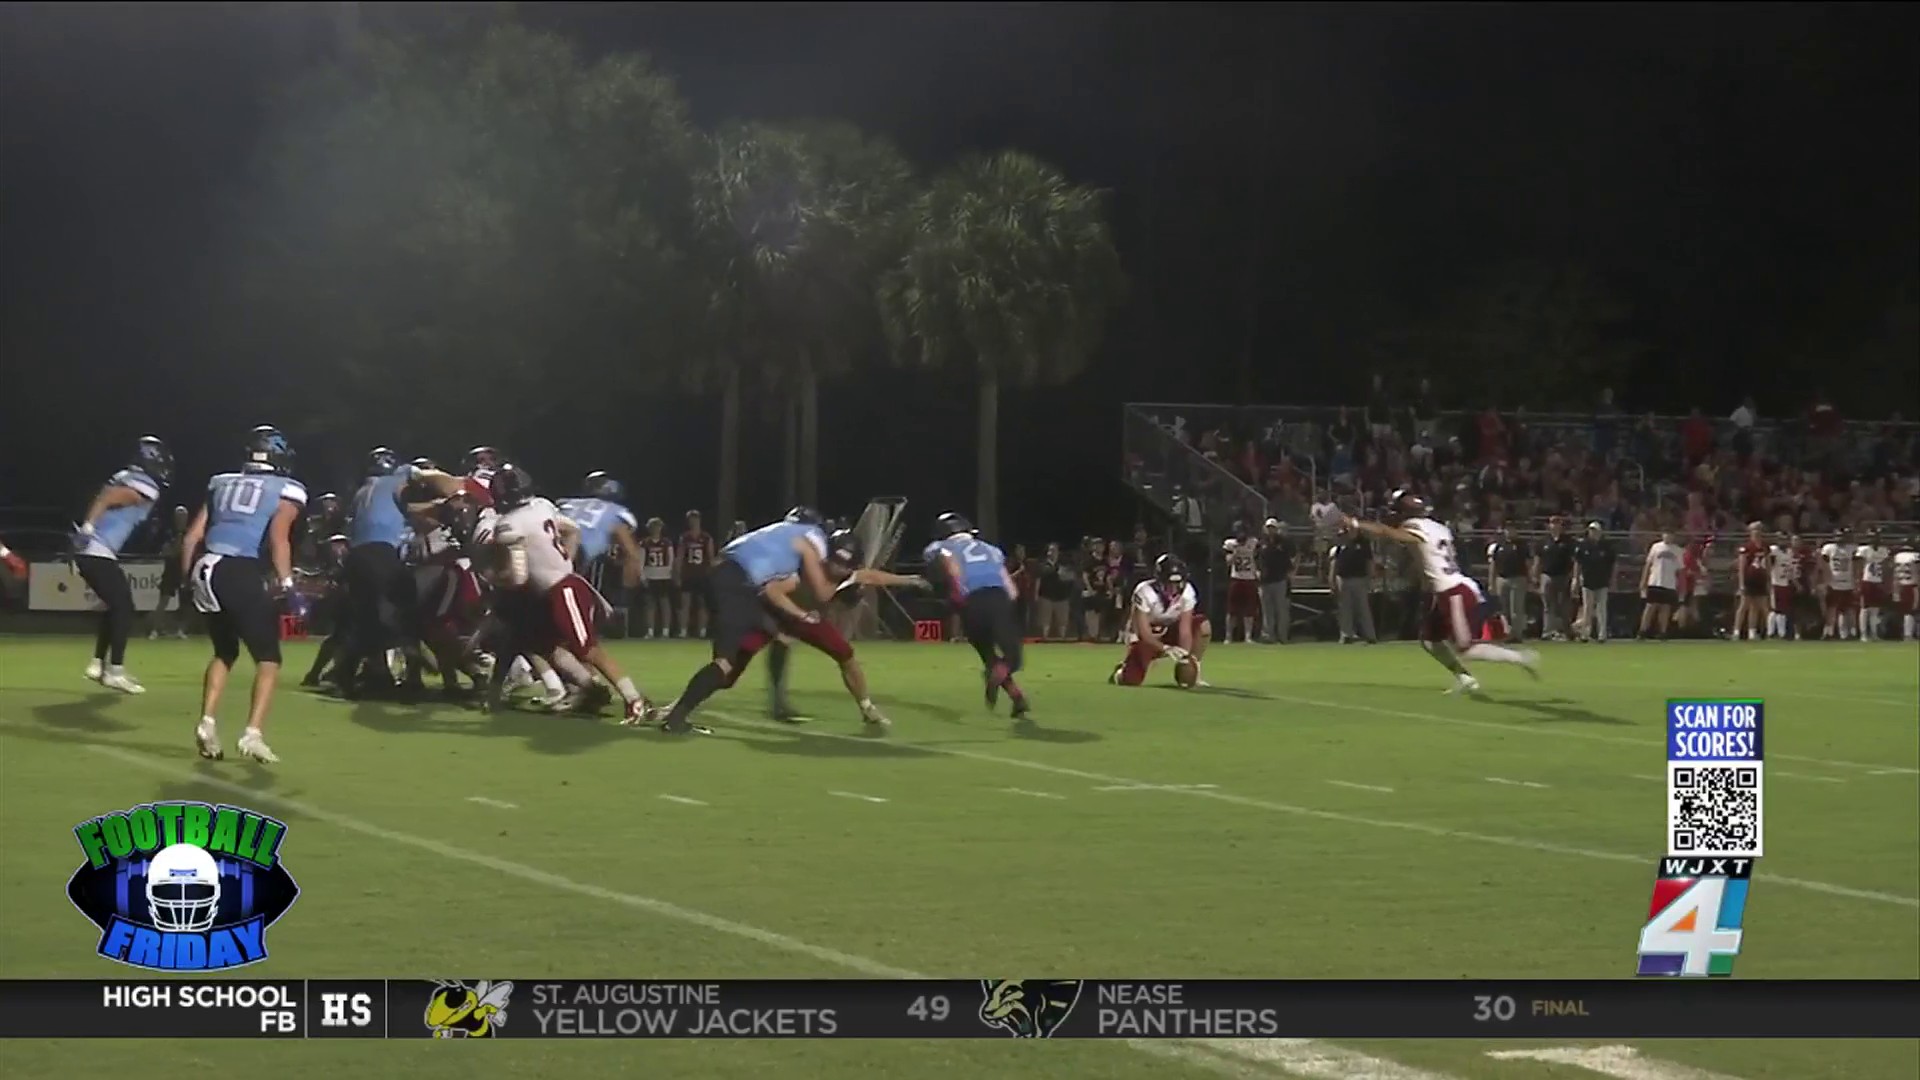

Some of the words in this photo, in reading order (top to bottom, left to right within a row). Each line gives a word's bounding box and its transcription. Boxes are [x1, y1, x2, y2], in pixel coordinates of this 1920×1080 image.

[216, 479, 264, 514] 10
[648, 552, 664, 567] 31
[918, 622, 940, 641] 20
